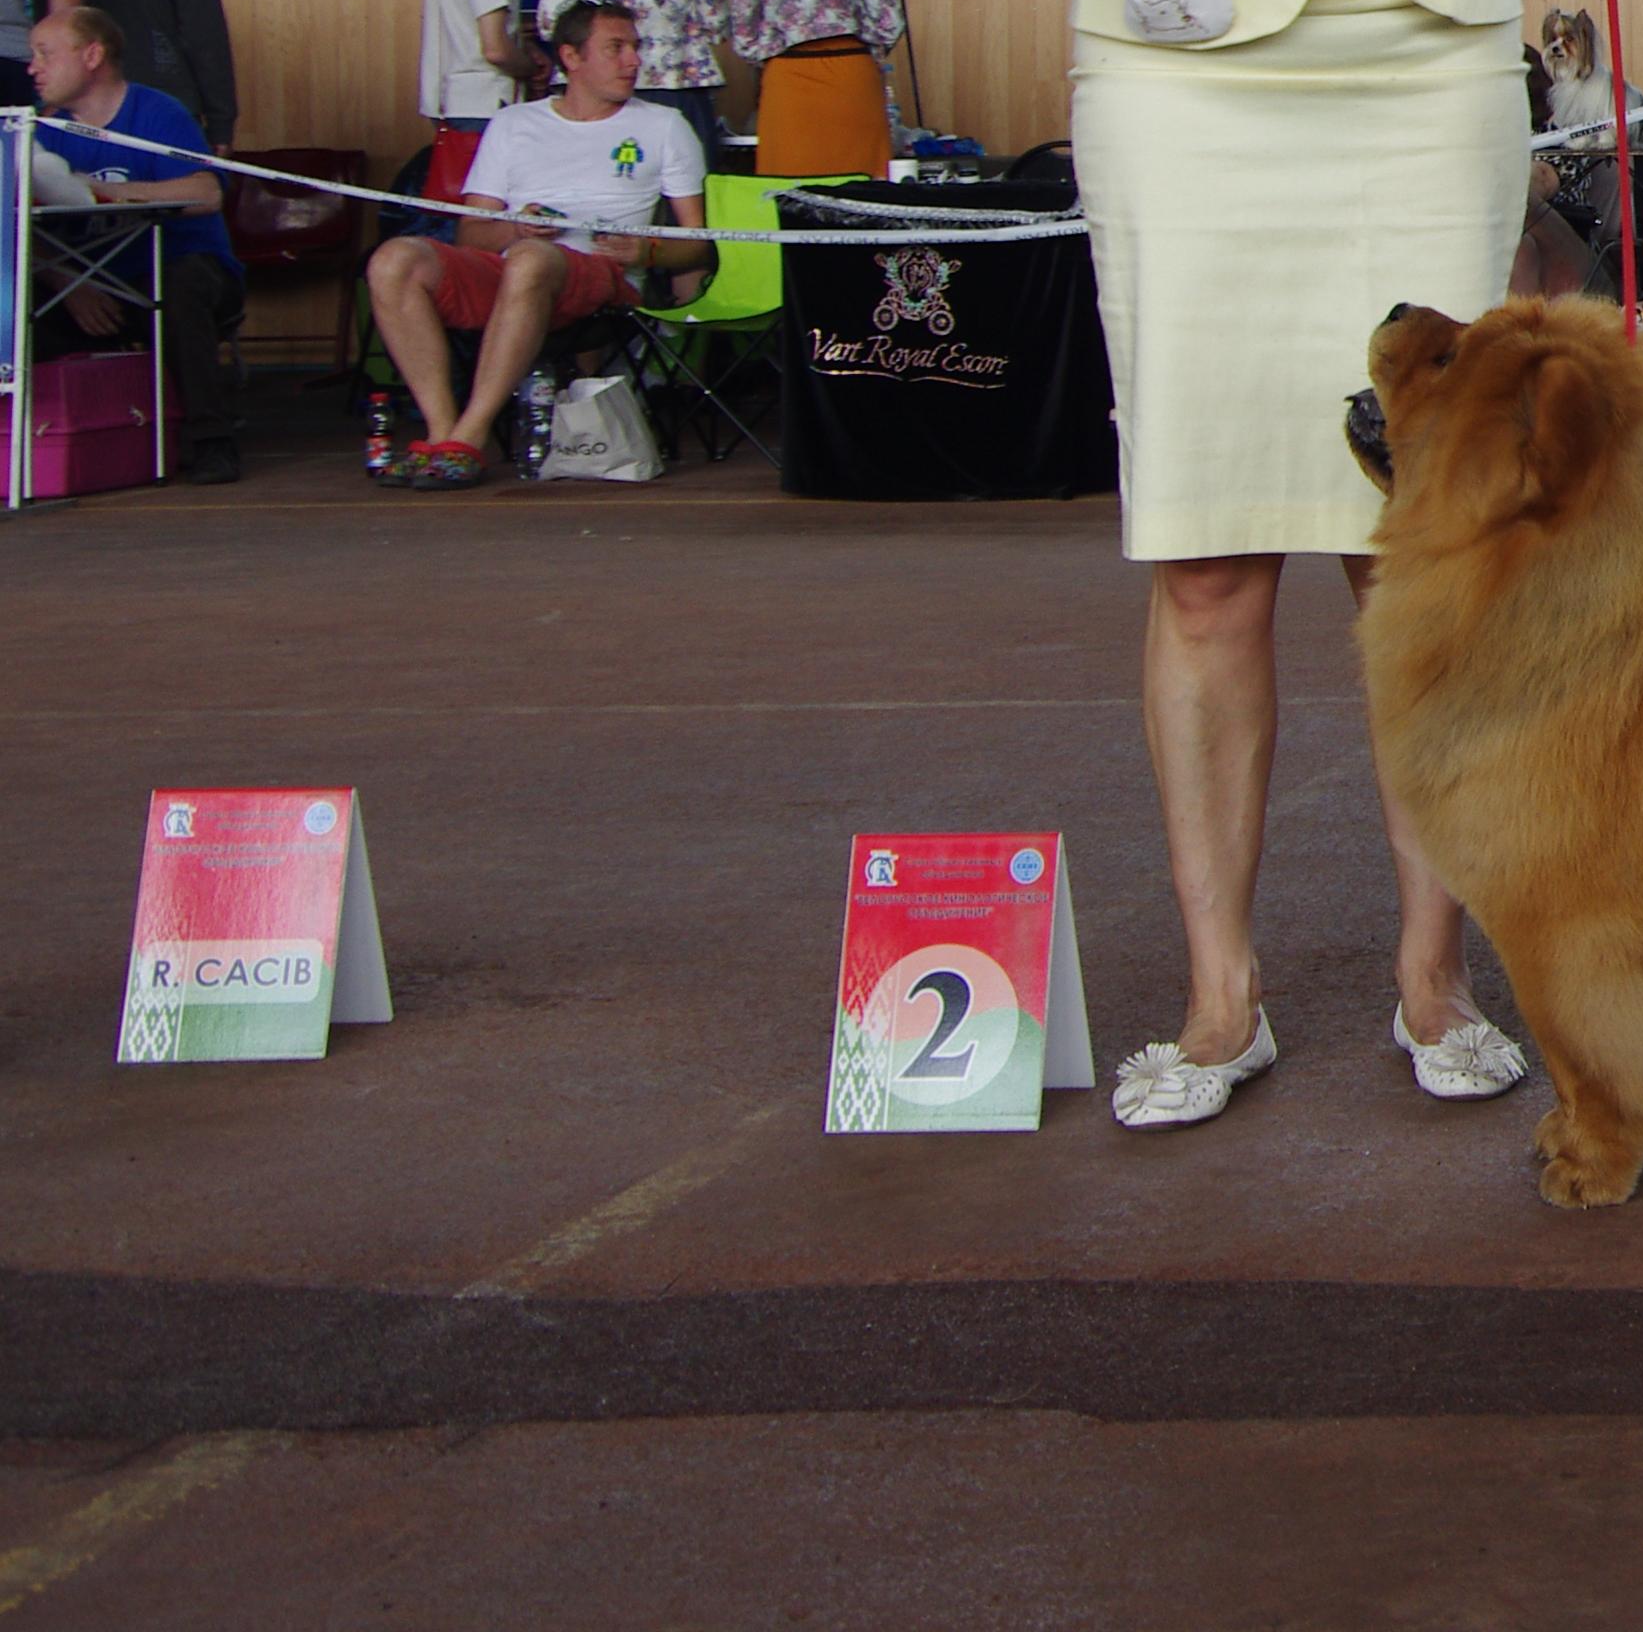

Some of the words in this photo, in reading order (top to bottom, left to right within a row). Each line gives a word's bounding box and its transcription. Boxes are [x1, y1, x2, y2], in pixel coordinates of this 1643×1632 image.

[861, 335, 943, 371] Royal
[151, 959, 179, 988] R.
[194, 956, 312, 987] CACIB
[894, 967, 979, 1082] 2
